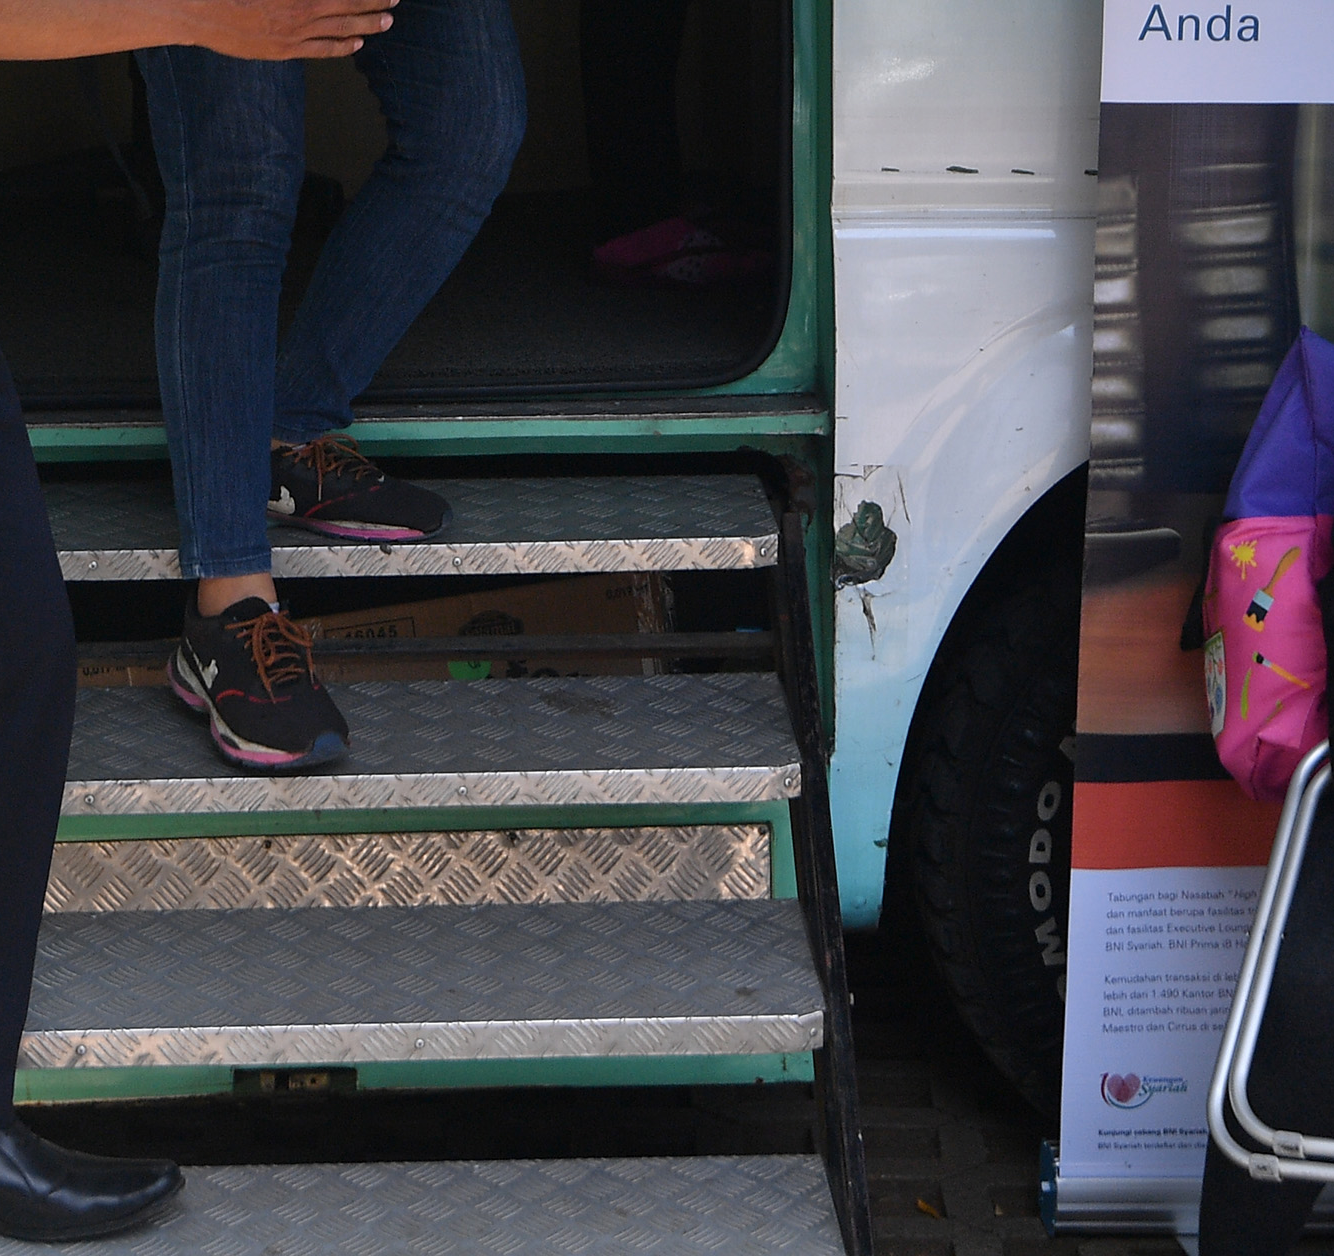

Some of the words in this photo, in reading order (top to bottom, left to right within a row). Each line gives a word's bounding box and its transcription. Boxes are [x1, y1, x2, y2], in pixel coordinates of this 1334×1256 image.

[1138, 4, 1261, 43] Anda
[1107, 892, 1155, 903] Tabungan
[1105, 942, 1124, 952] BNI
[1168, 939, 1188, 950] BNI
